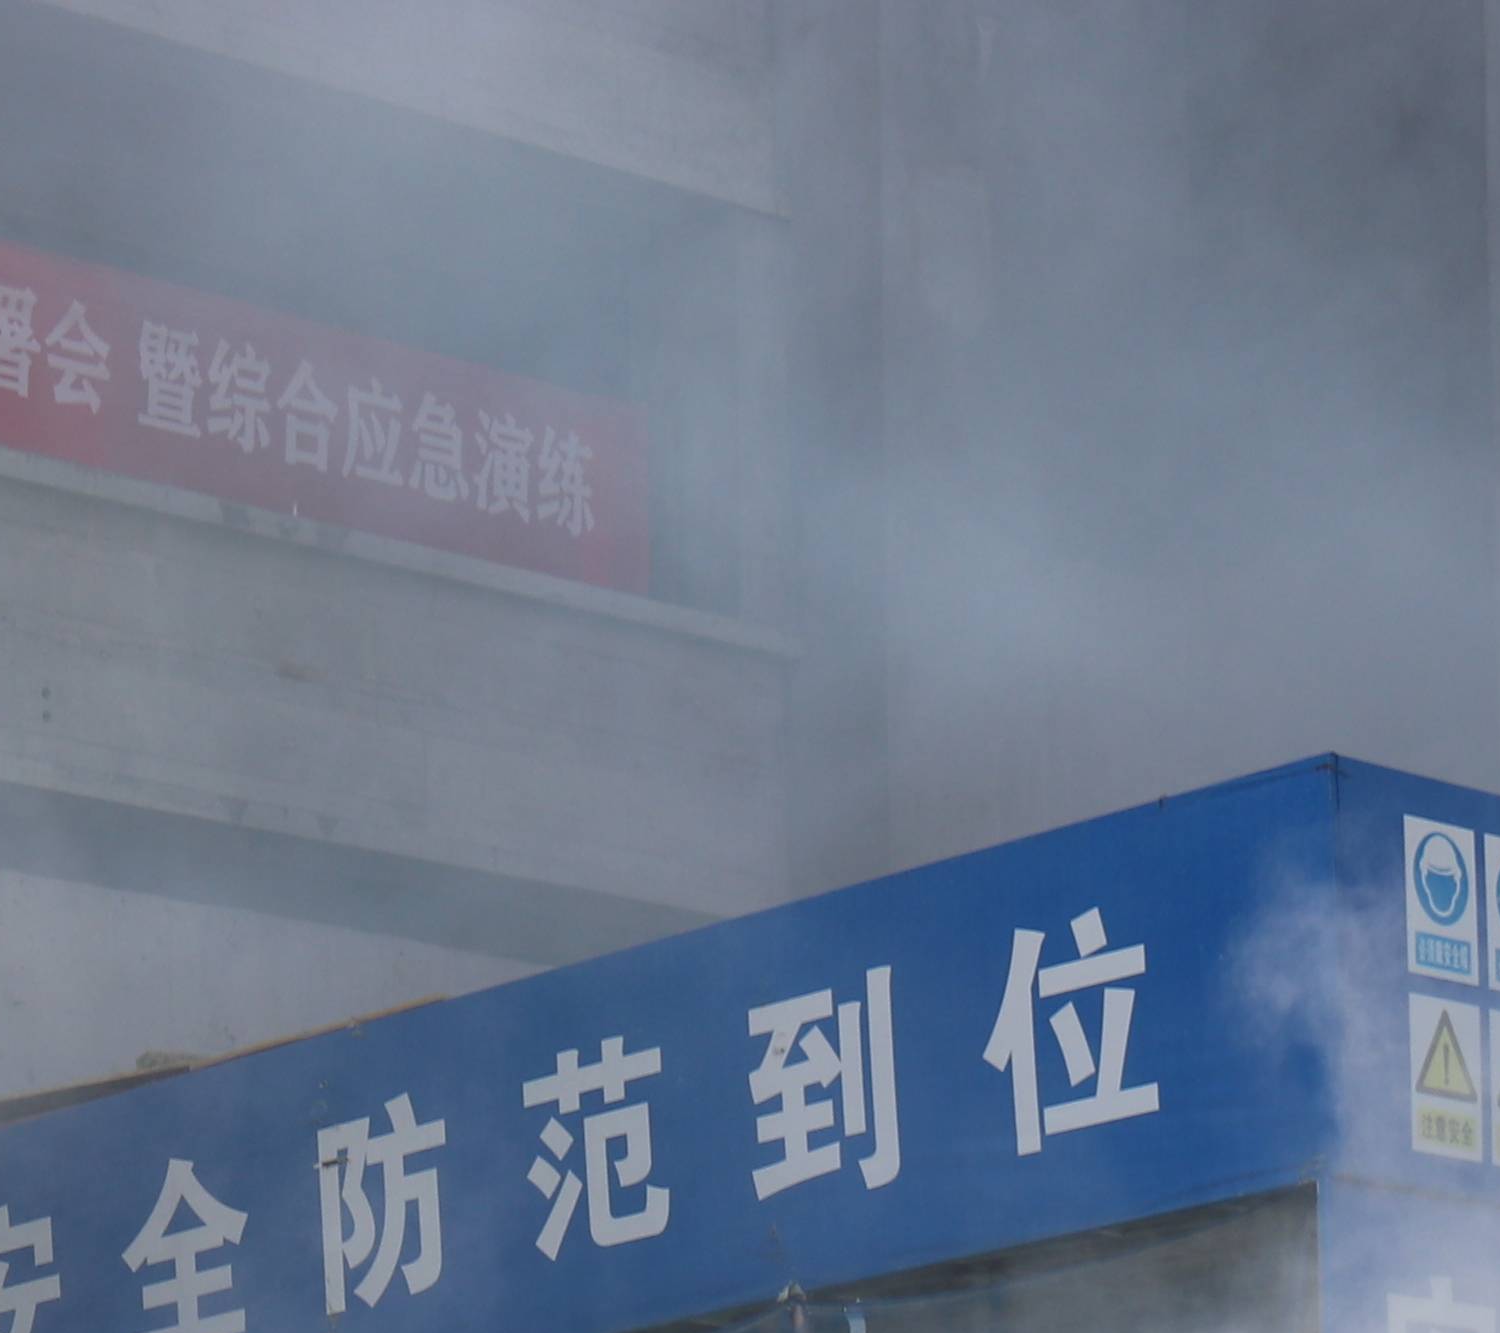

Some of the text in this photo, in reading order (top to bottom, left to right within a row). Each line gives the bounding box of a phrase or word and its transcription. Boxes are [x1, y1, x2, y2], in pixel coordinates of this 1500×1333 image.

[136, 319, 596, 541] 暨综合应急演练
